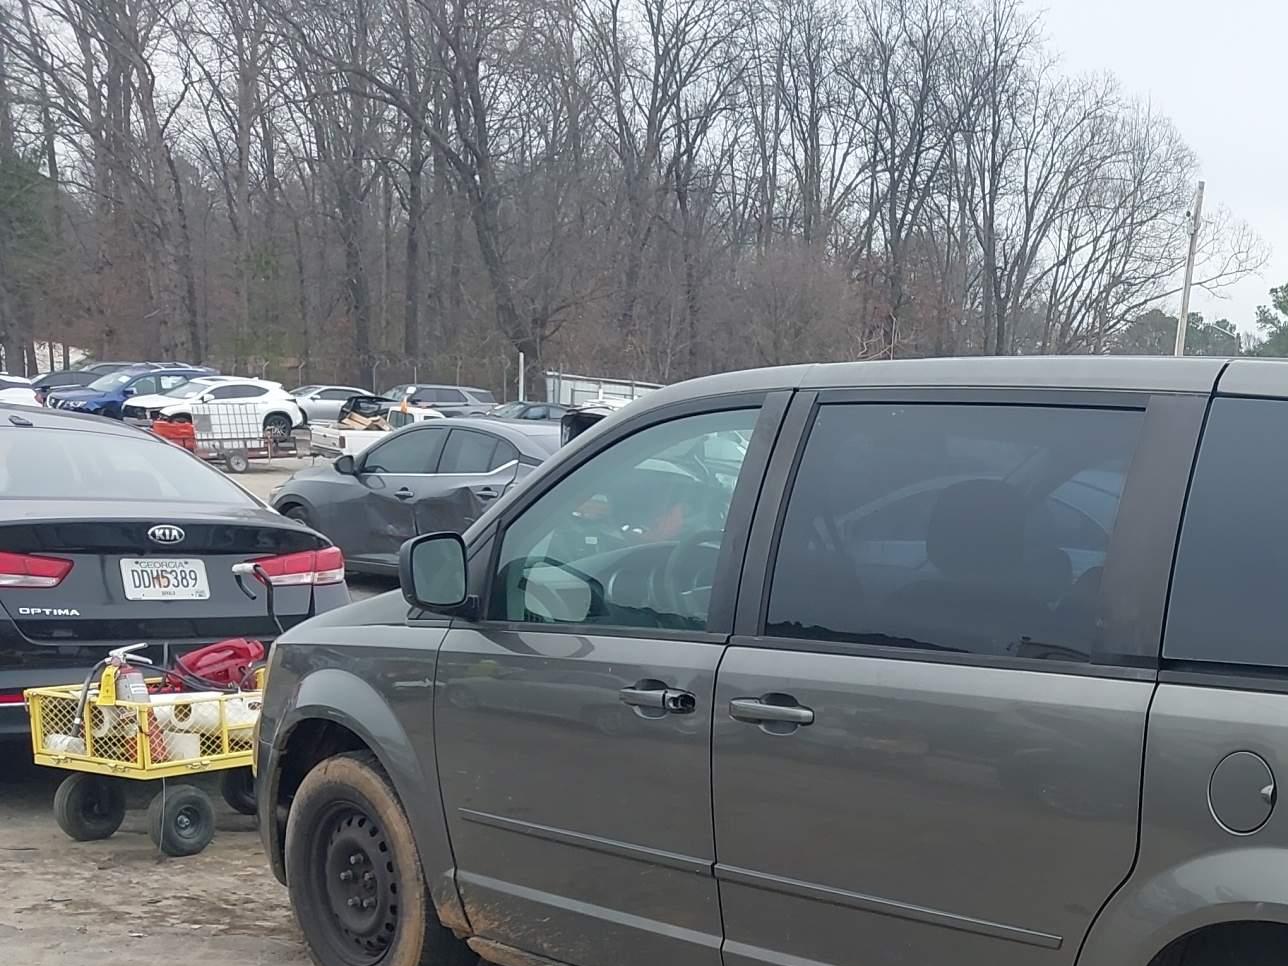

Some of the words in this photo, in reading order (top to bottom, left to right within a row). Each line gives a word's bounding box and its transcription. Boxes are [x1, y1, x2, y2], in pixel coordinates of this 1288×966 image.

[154, 528, 180, 541] KIA
[139, 561, 185, 569] GEORGIA
[130, 569, 198, 589] DDH5389
[18, 607, 80, 616] OPTIMA
